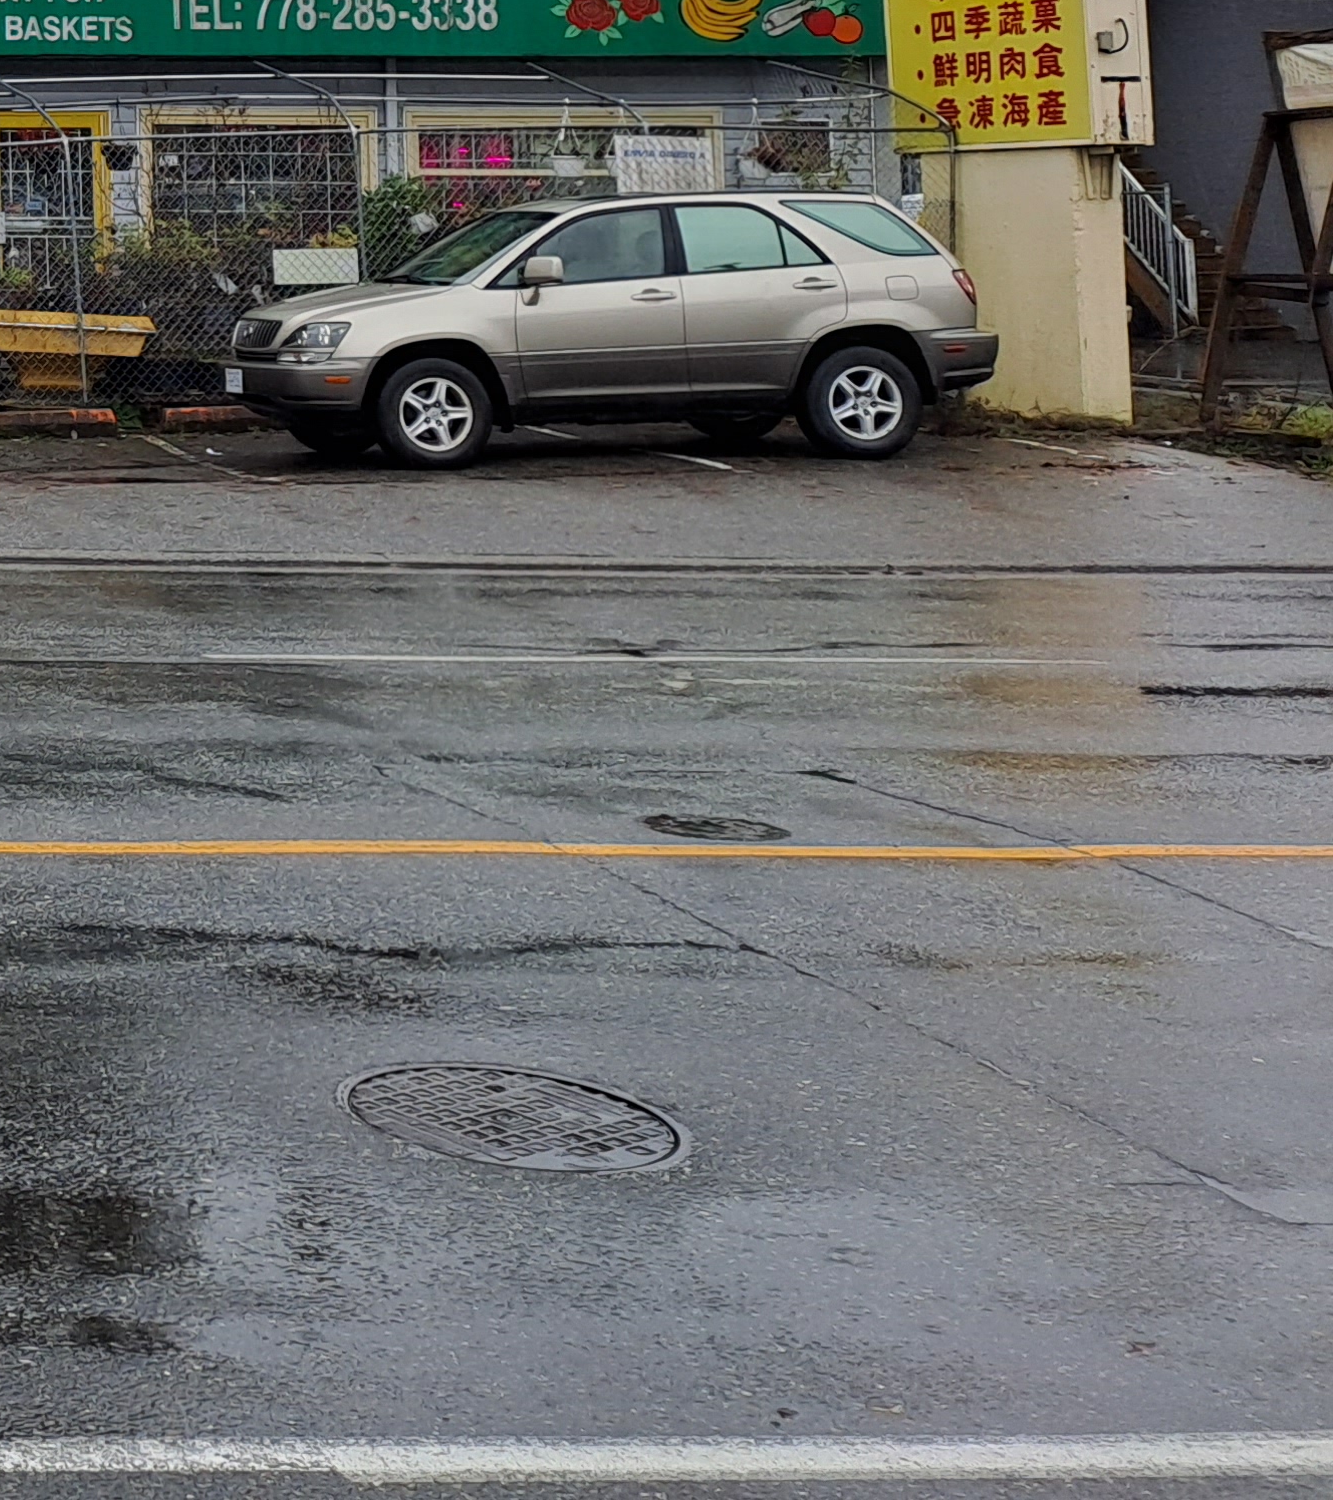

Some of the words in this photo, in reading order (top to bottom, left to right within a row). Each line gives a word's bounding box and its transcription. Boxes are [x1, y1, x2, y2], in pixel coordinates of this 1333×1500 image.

[4, 15, 133, 42] BASKETS
[932, 42, 1066, 88] 鮮明肉食
